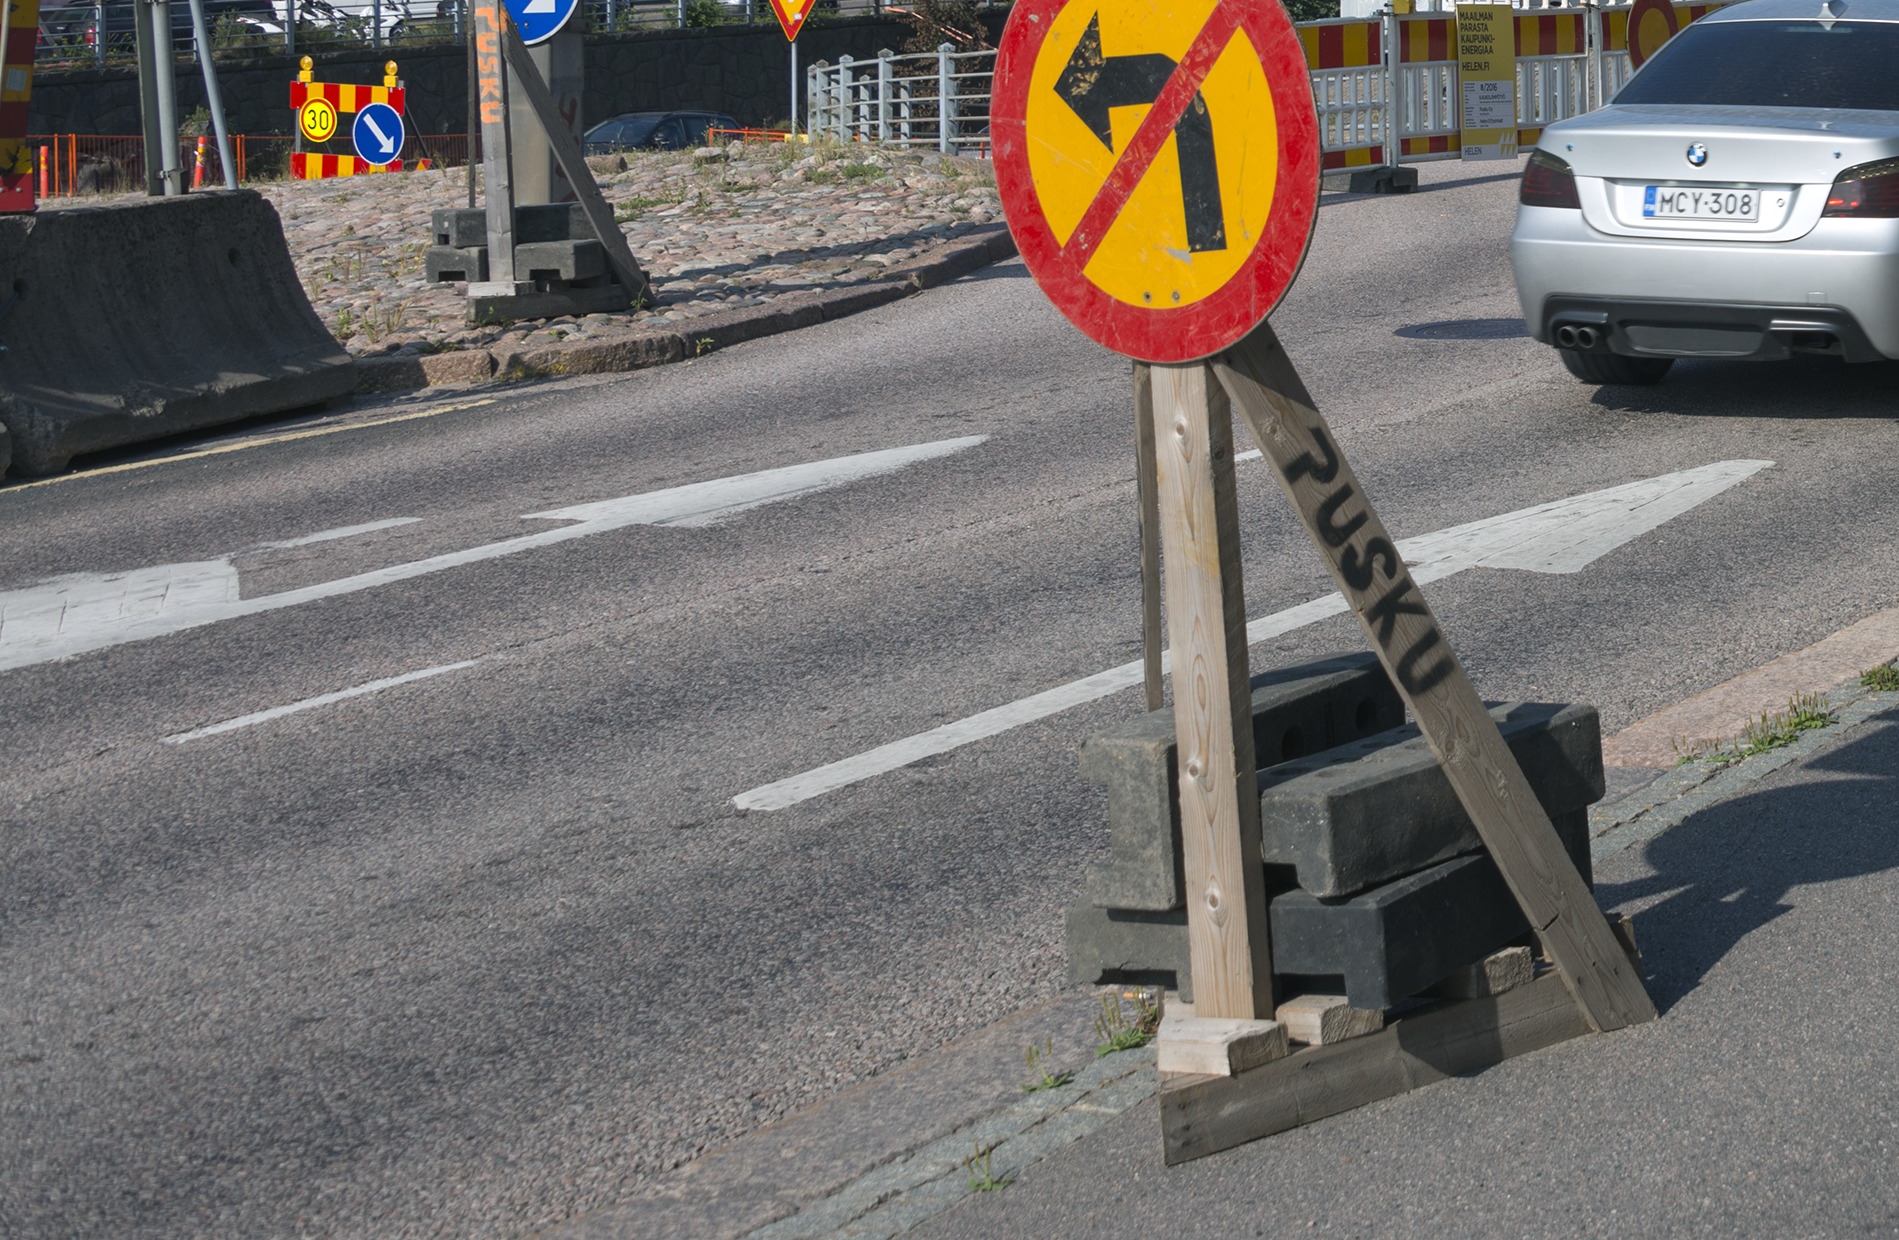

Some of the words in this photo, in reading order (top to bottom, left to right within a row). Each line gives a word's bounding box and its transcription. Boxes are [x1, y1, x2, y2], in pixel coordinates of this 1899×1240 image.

[1459, 11, 1494, 21] MAAILMAN
[1460, 22, 1489, 33] PARASTA
[1460, 33, 1496, 44] KAUPUNKI-
[1461, 45, 1494, 55] ENERGIAA
[475, 6, 507, 124] PUSKU
[1461, 61, 1490, 72] HELEN.FI
[307, 109, 329, 131] 30
[1464, 146, 1483, 156] HELEN
[1659, 191, 1752, 216] MCY-308
[1283, 426, 1455, 696] PUSKU
